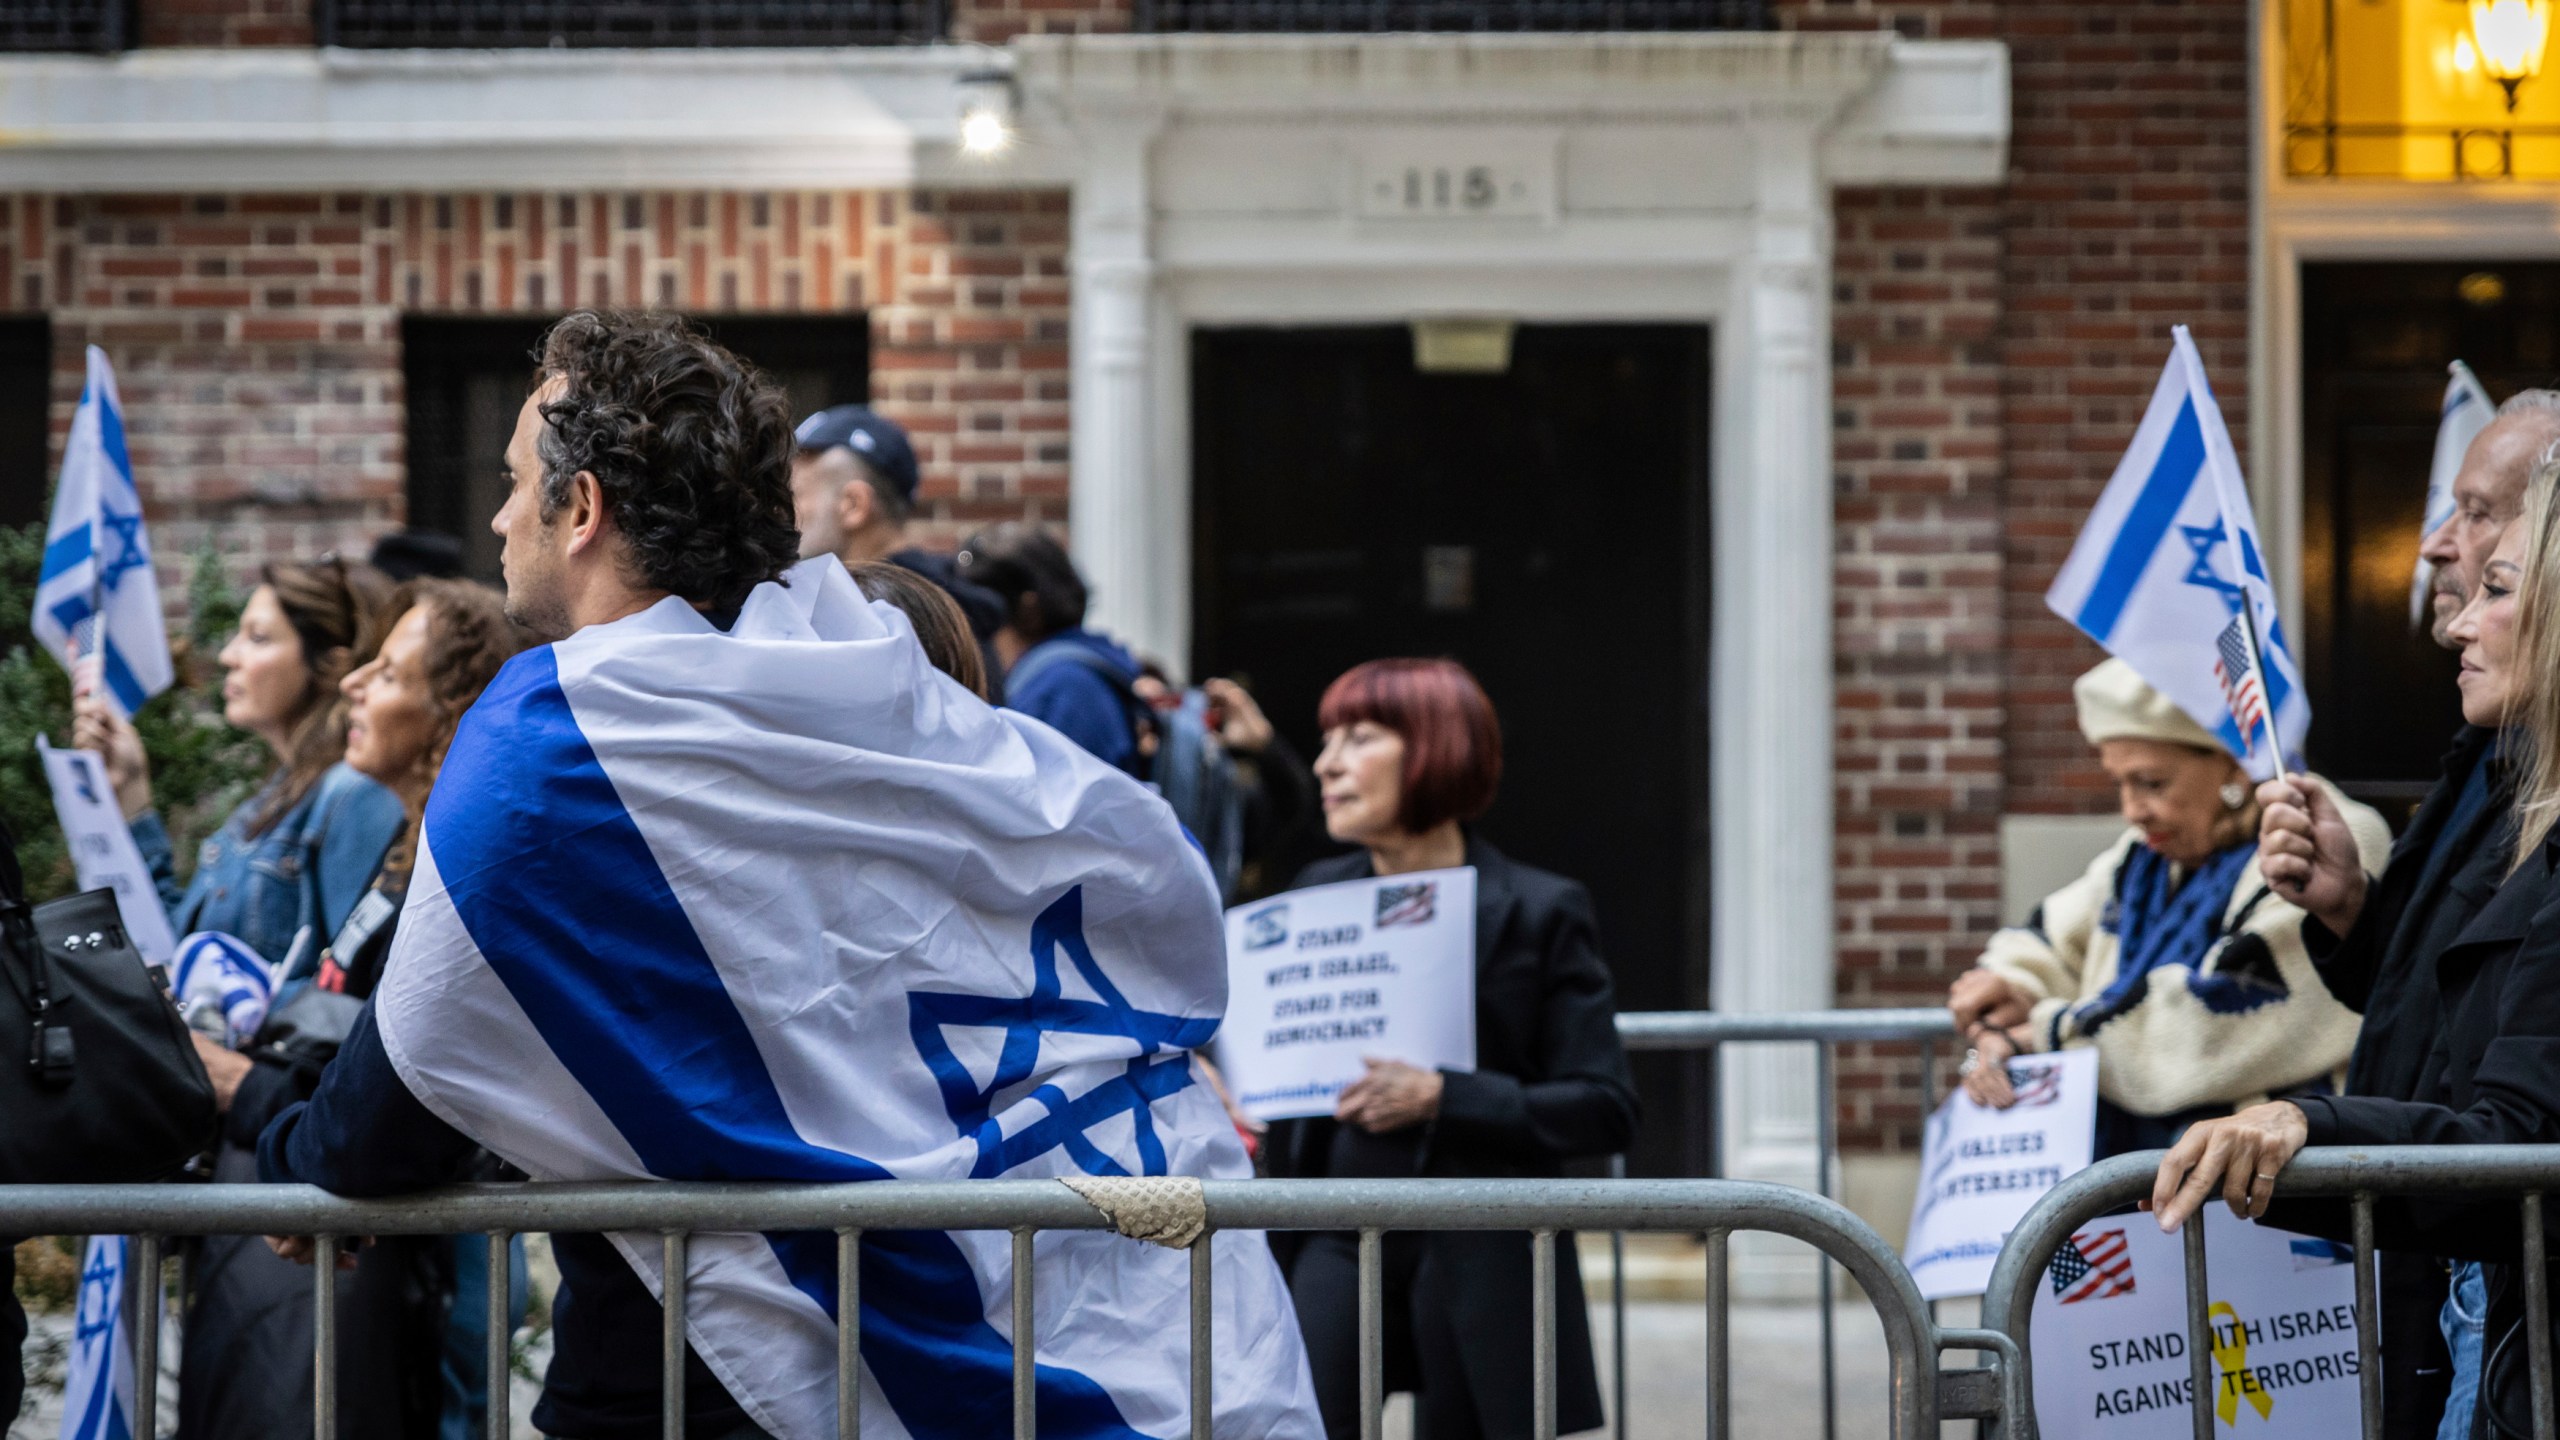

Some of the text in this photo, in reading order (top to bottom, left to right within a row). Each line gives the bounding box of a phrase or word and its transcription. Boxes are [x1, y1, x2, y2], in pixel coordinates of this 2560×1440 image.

[1405, 166, 1498, 209] 115
[1297, 925, 1361, 949] STAND
[1266, 963, 1311, 986] WITH
[1274, 989, 1380, 1017] STAND FOR
[1264, 1017, 1387, 1046] DEMOCRACY
[1960, 1132, 2045, 1157] VALUES
[2090, 1333, 2185, 1370] STAND
[2209, 1320, 2263, 1352] ITH
[2095, 1351, 2361, 1420] AGAINS TERRORIS
